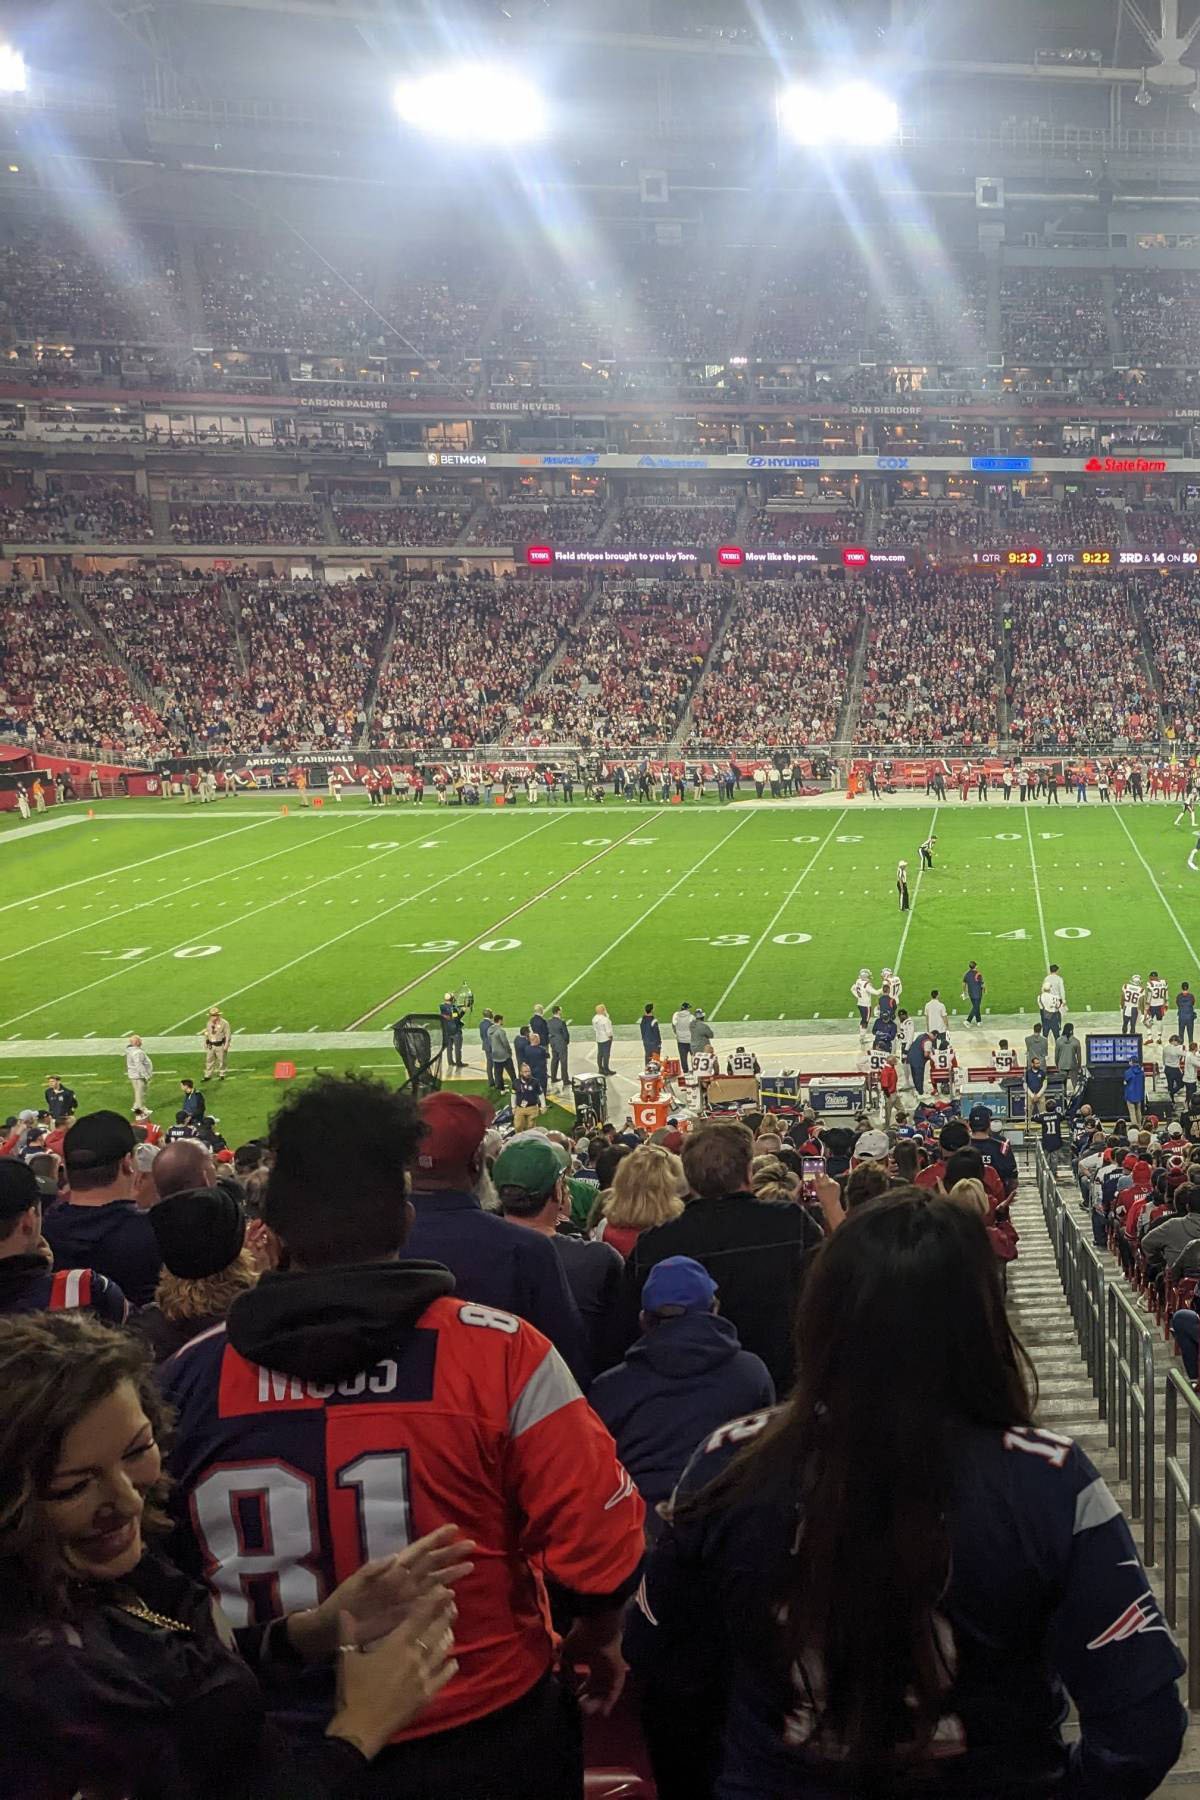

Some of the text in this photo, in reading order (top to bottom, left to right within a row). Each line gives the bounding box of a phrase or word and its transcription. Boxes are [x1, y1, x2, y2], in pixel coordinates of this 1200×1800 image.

[301, 398, 388, 409] CARSON PALMER
[489, 402, 519, 411] ERNIE
[851, 406, 921, 415] DAN DIERDORF
[440, 455, 487, 465] BETMGM
[768, 458, 820, 467] HYUNDAI
[876, 458, 909, 468] COX
[555, 552, 575, 560] Field
[577, 552, 603, 562] stripes
[605, 552, 637, 562] brought
[649, 554, 665, 562] you
[666, 552, 677, 562] by
[746, 553, 765, 561] Mow
[767, 553, 782, 561] like
[783, 553, 796, 561] the
[982, 553, 1000, 562] QTR
[1056, 554, 1074, 562] QTR
[1082, 553, 1110, 563] 9:22
[1120, 553, 1197, 562] 3RD & 14 ON 50
[246, 755, 354, 766] ARIZONA CARDINALS
[1125, 990, 1140, 1004] 36
[1153, 988, 1166, 1000] 30
[692, 1058, 710, 1071] 93
[734, 1057, 752, 1070] 92
[938, 1056, 948, 1068] 9
[997, 1106, 1007, 1114] 12
[640, 1109, 657, 1126] G
[1046, 1121, 1056, 1135] 11
[190, 1450, 412, 1631] 81
